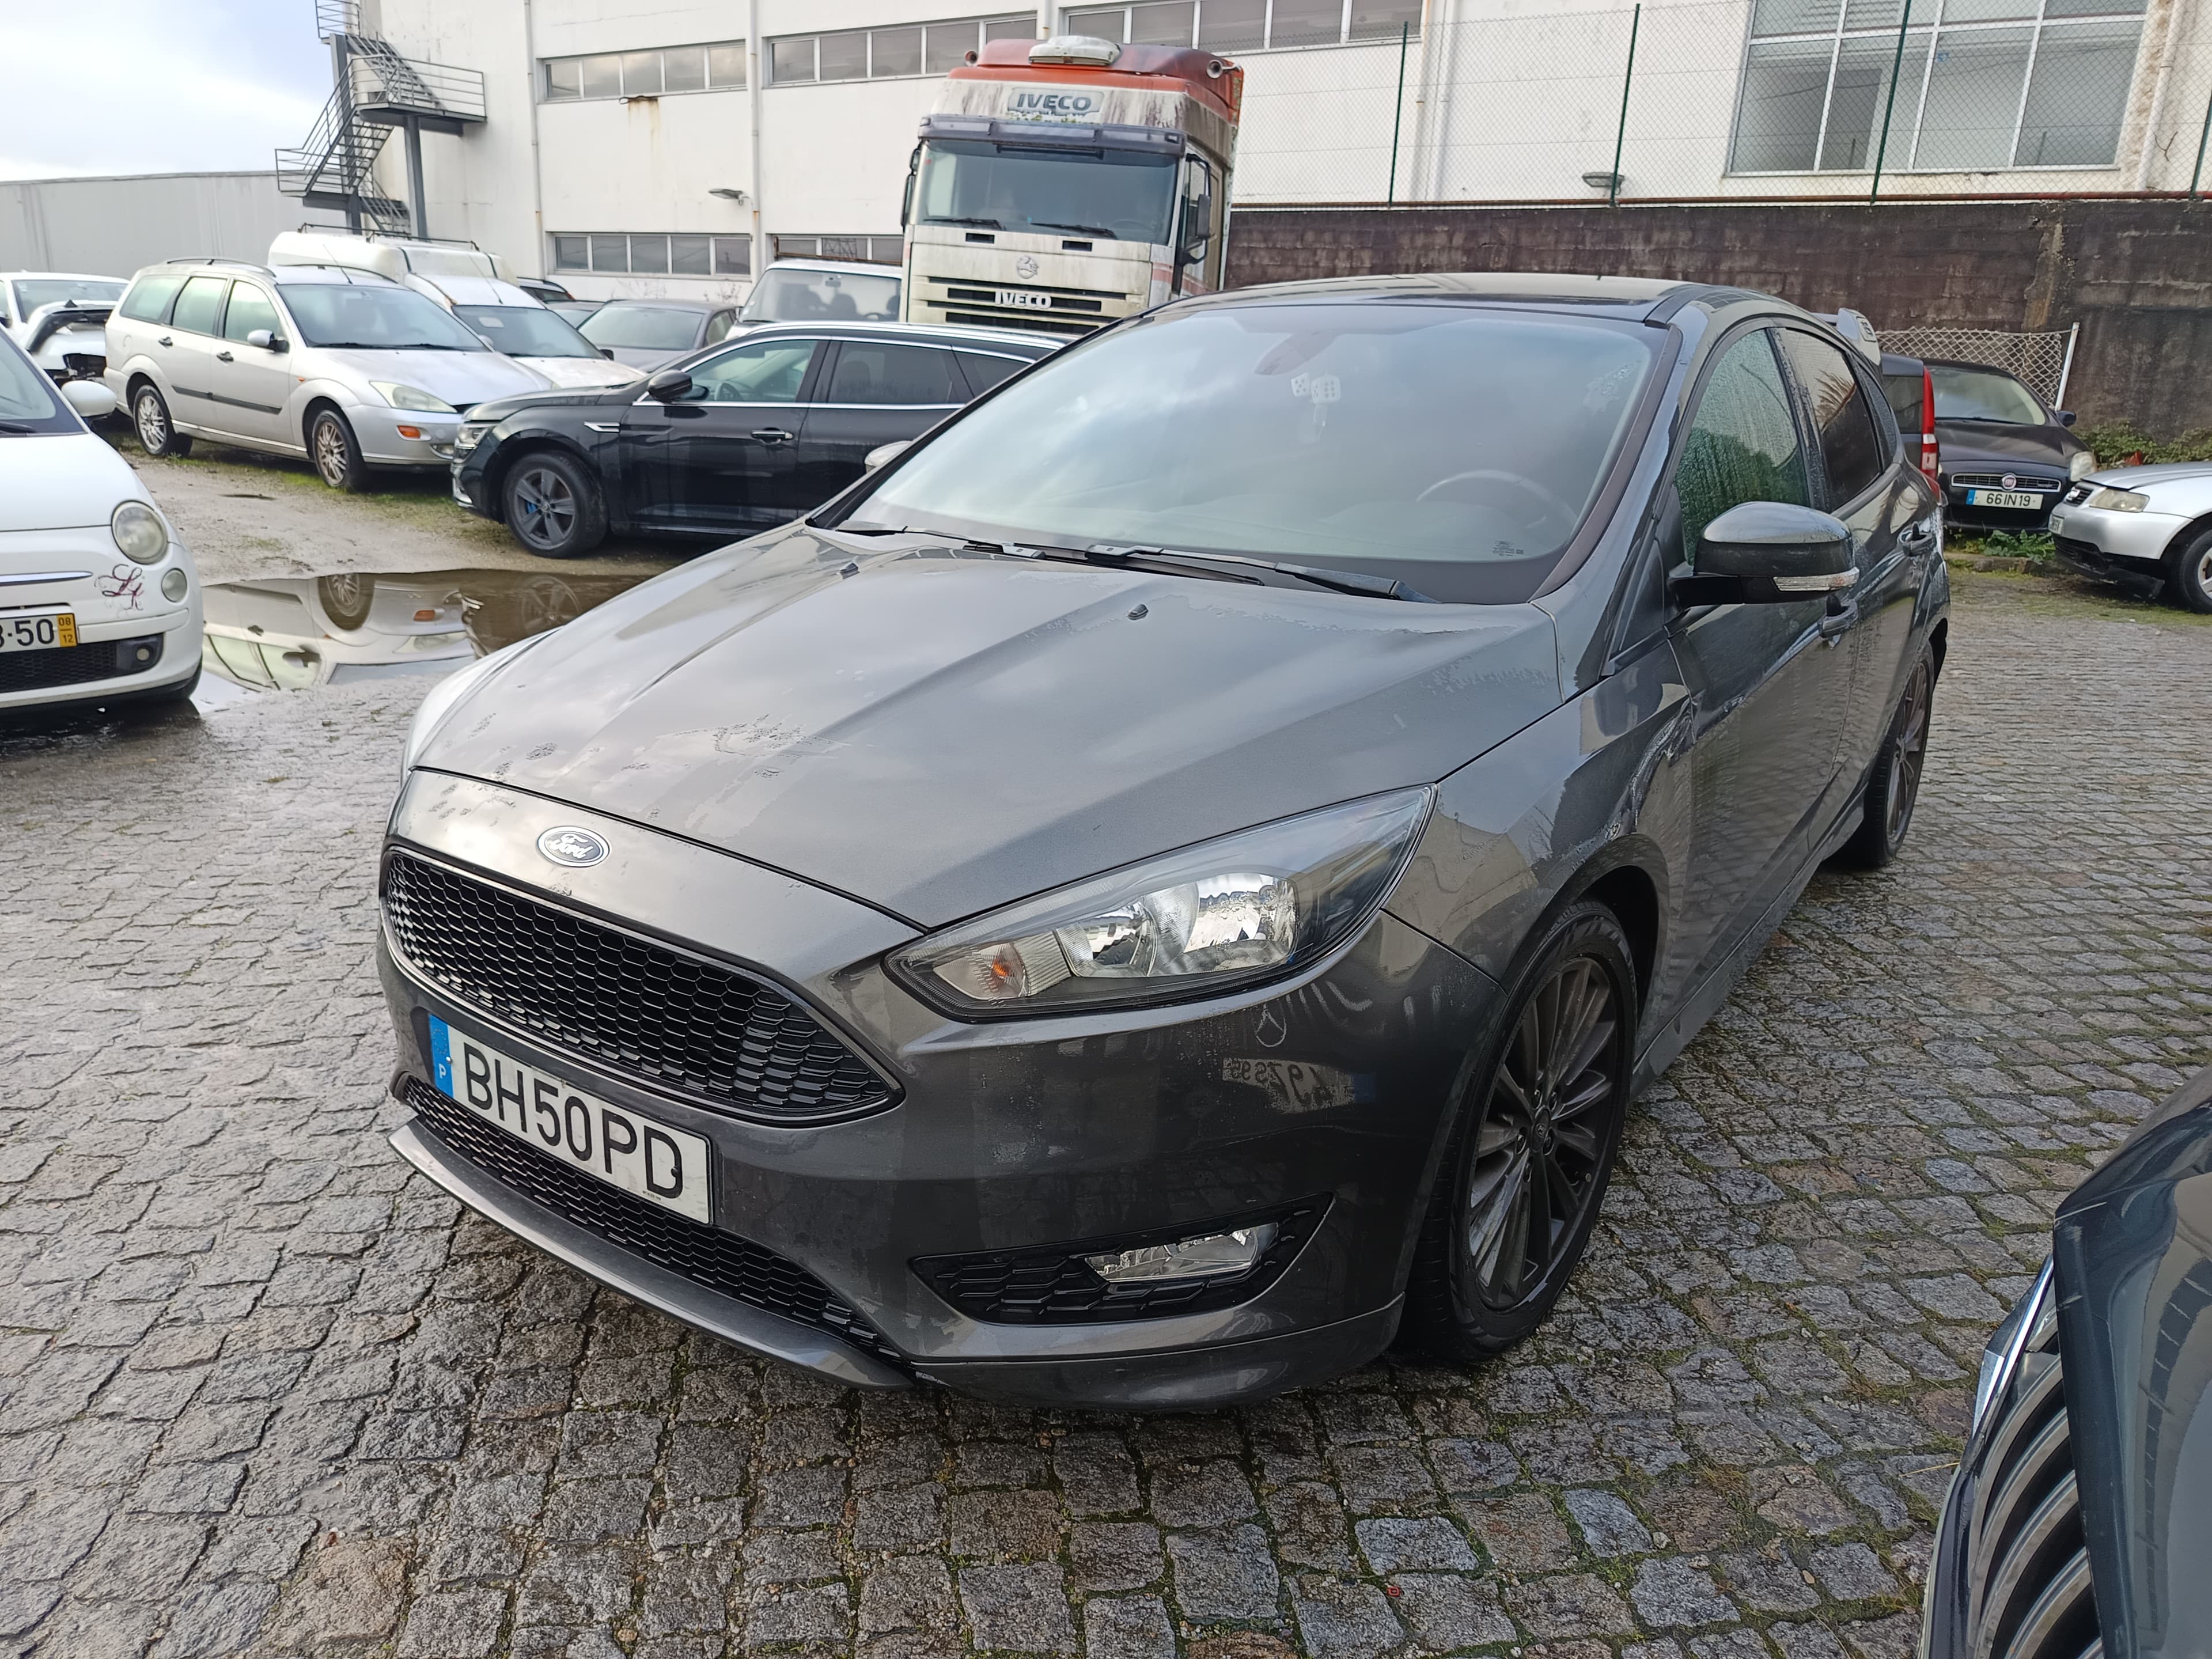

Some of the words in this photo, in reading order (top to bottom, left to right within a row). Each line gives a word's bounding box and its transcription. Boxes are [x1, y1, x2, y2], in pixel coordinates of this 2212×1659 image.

[1017, 93, 1091, 111] IVECO
[995, 291, 1051, 309] IVECO
[58, 617, 71, 626] 08
[0, 619, 55, 648] -50
[63, 634, 74, 643] 12
[547, 833, 593, 859] Ford
[438, 1063, 446, 1079] P
[464, 1042, 683, 1199] BH50PD
